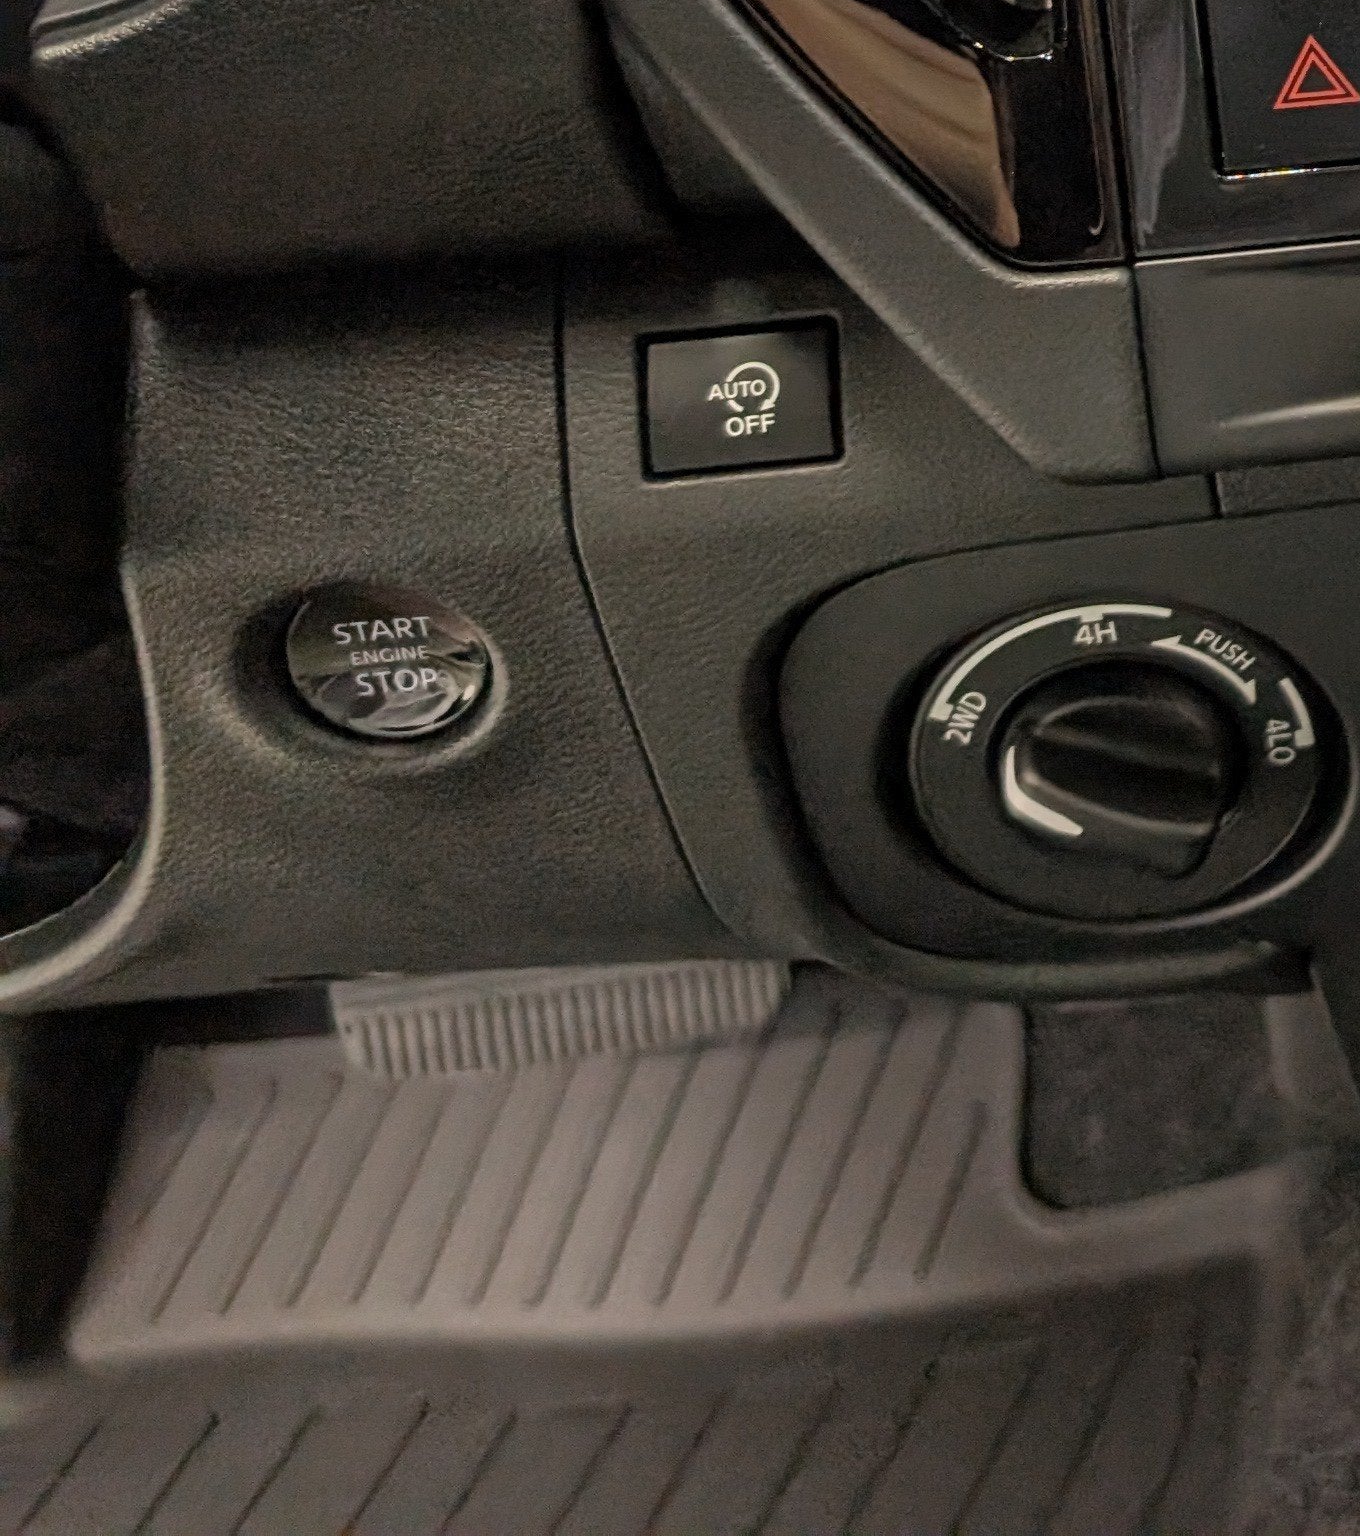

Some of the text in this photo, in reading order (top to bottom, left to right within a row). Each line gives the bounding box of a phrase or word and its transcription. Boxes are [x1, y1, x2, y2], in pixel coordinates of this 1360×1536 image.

[707, 379, 766, 402] AUTO
[725, 413, 776, 437] OFF
[333, 615, 430, 645] START
[1073, 621, 1117, 646] 4H
[350, 645, 427, 665] ENGINE
[1195, 628, 1256, 672] PUSH
[355, 668, 438, 698] STOP
[942, 691, 988, 746] 2WD
[1265, 718, 1297, 766] 4LO
